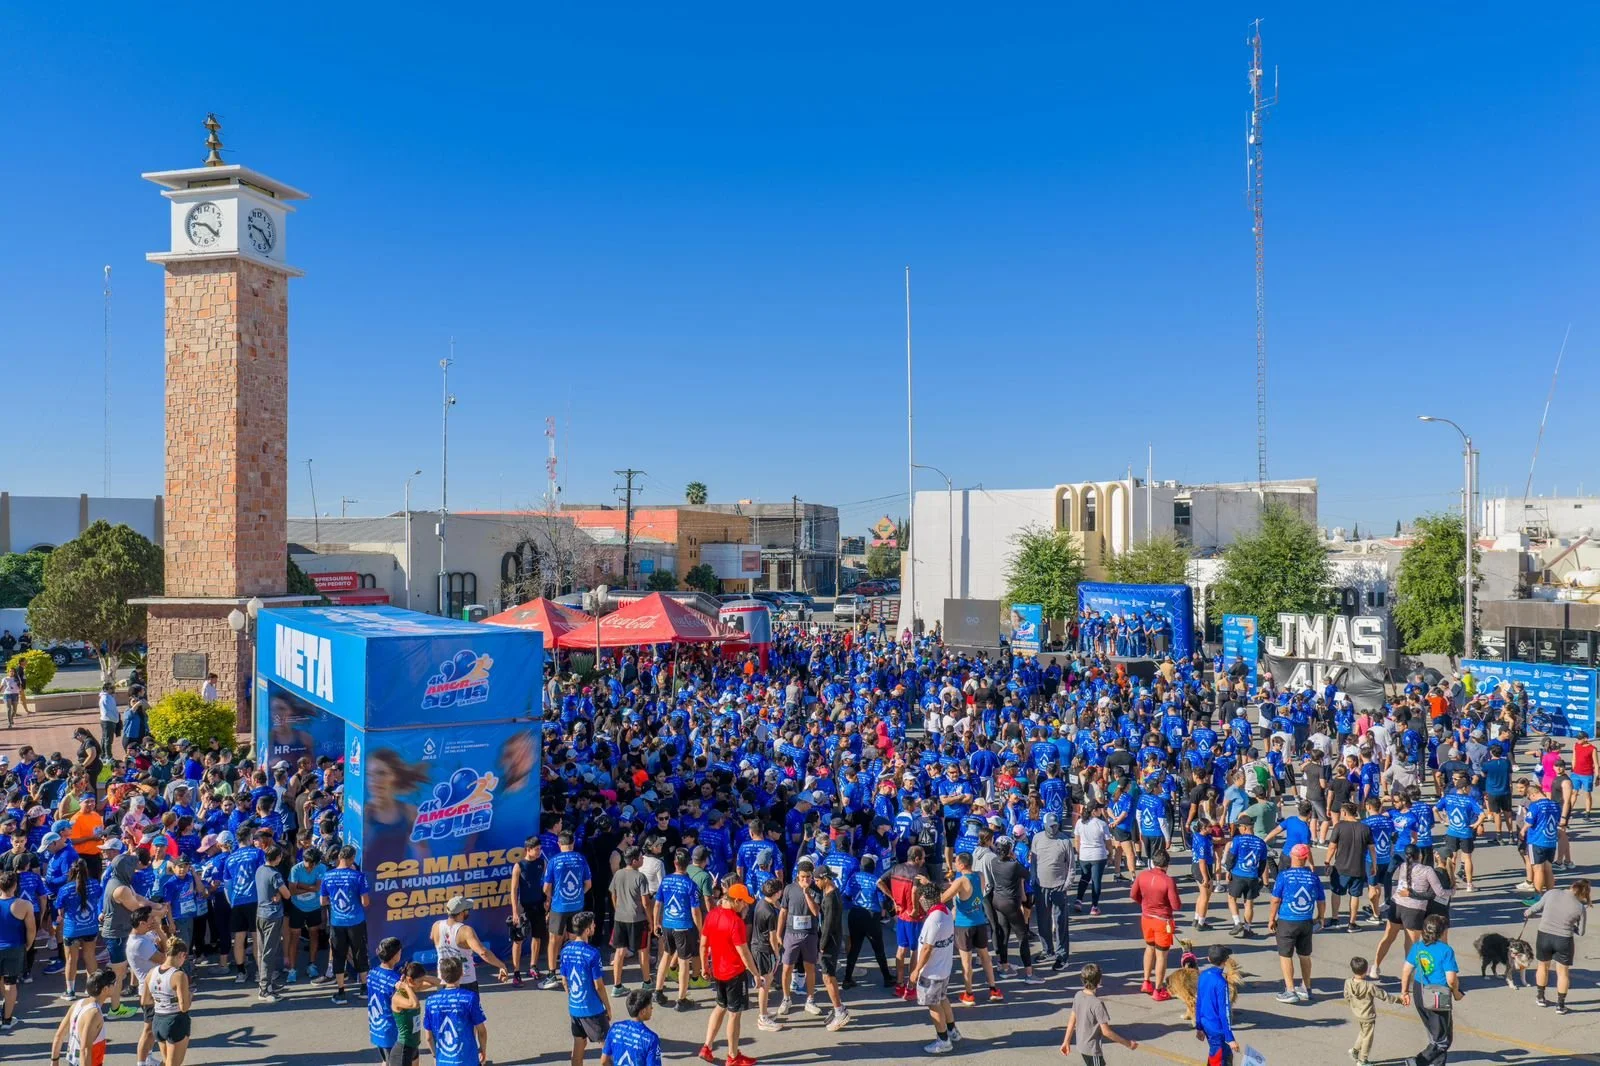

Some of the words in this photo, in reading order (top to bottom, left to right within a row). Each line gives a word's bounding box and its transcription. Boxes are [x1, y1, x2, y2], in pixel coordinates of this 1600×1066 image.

[1265, 613, 1384, 664] JMAS
[276, 624, 333, 703] META
[426, 680, 470, 694] AMOR
[428, 676, 444, 684] 4K
[274, 746, 290, 754] HR
[417, 804, 469, 824] AMOR
[419, 800, 440, 812] 4K
[411, 809, 491, 841] agua
[376, 859, 419, 879] 22
[423, 847, 525, 874] MARZO
[375, 878, 398, 892] DÍA
[401, 873, 462, 888] MUNDIAL
[464, 871, 489, 881] DEL
